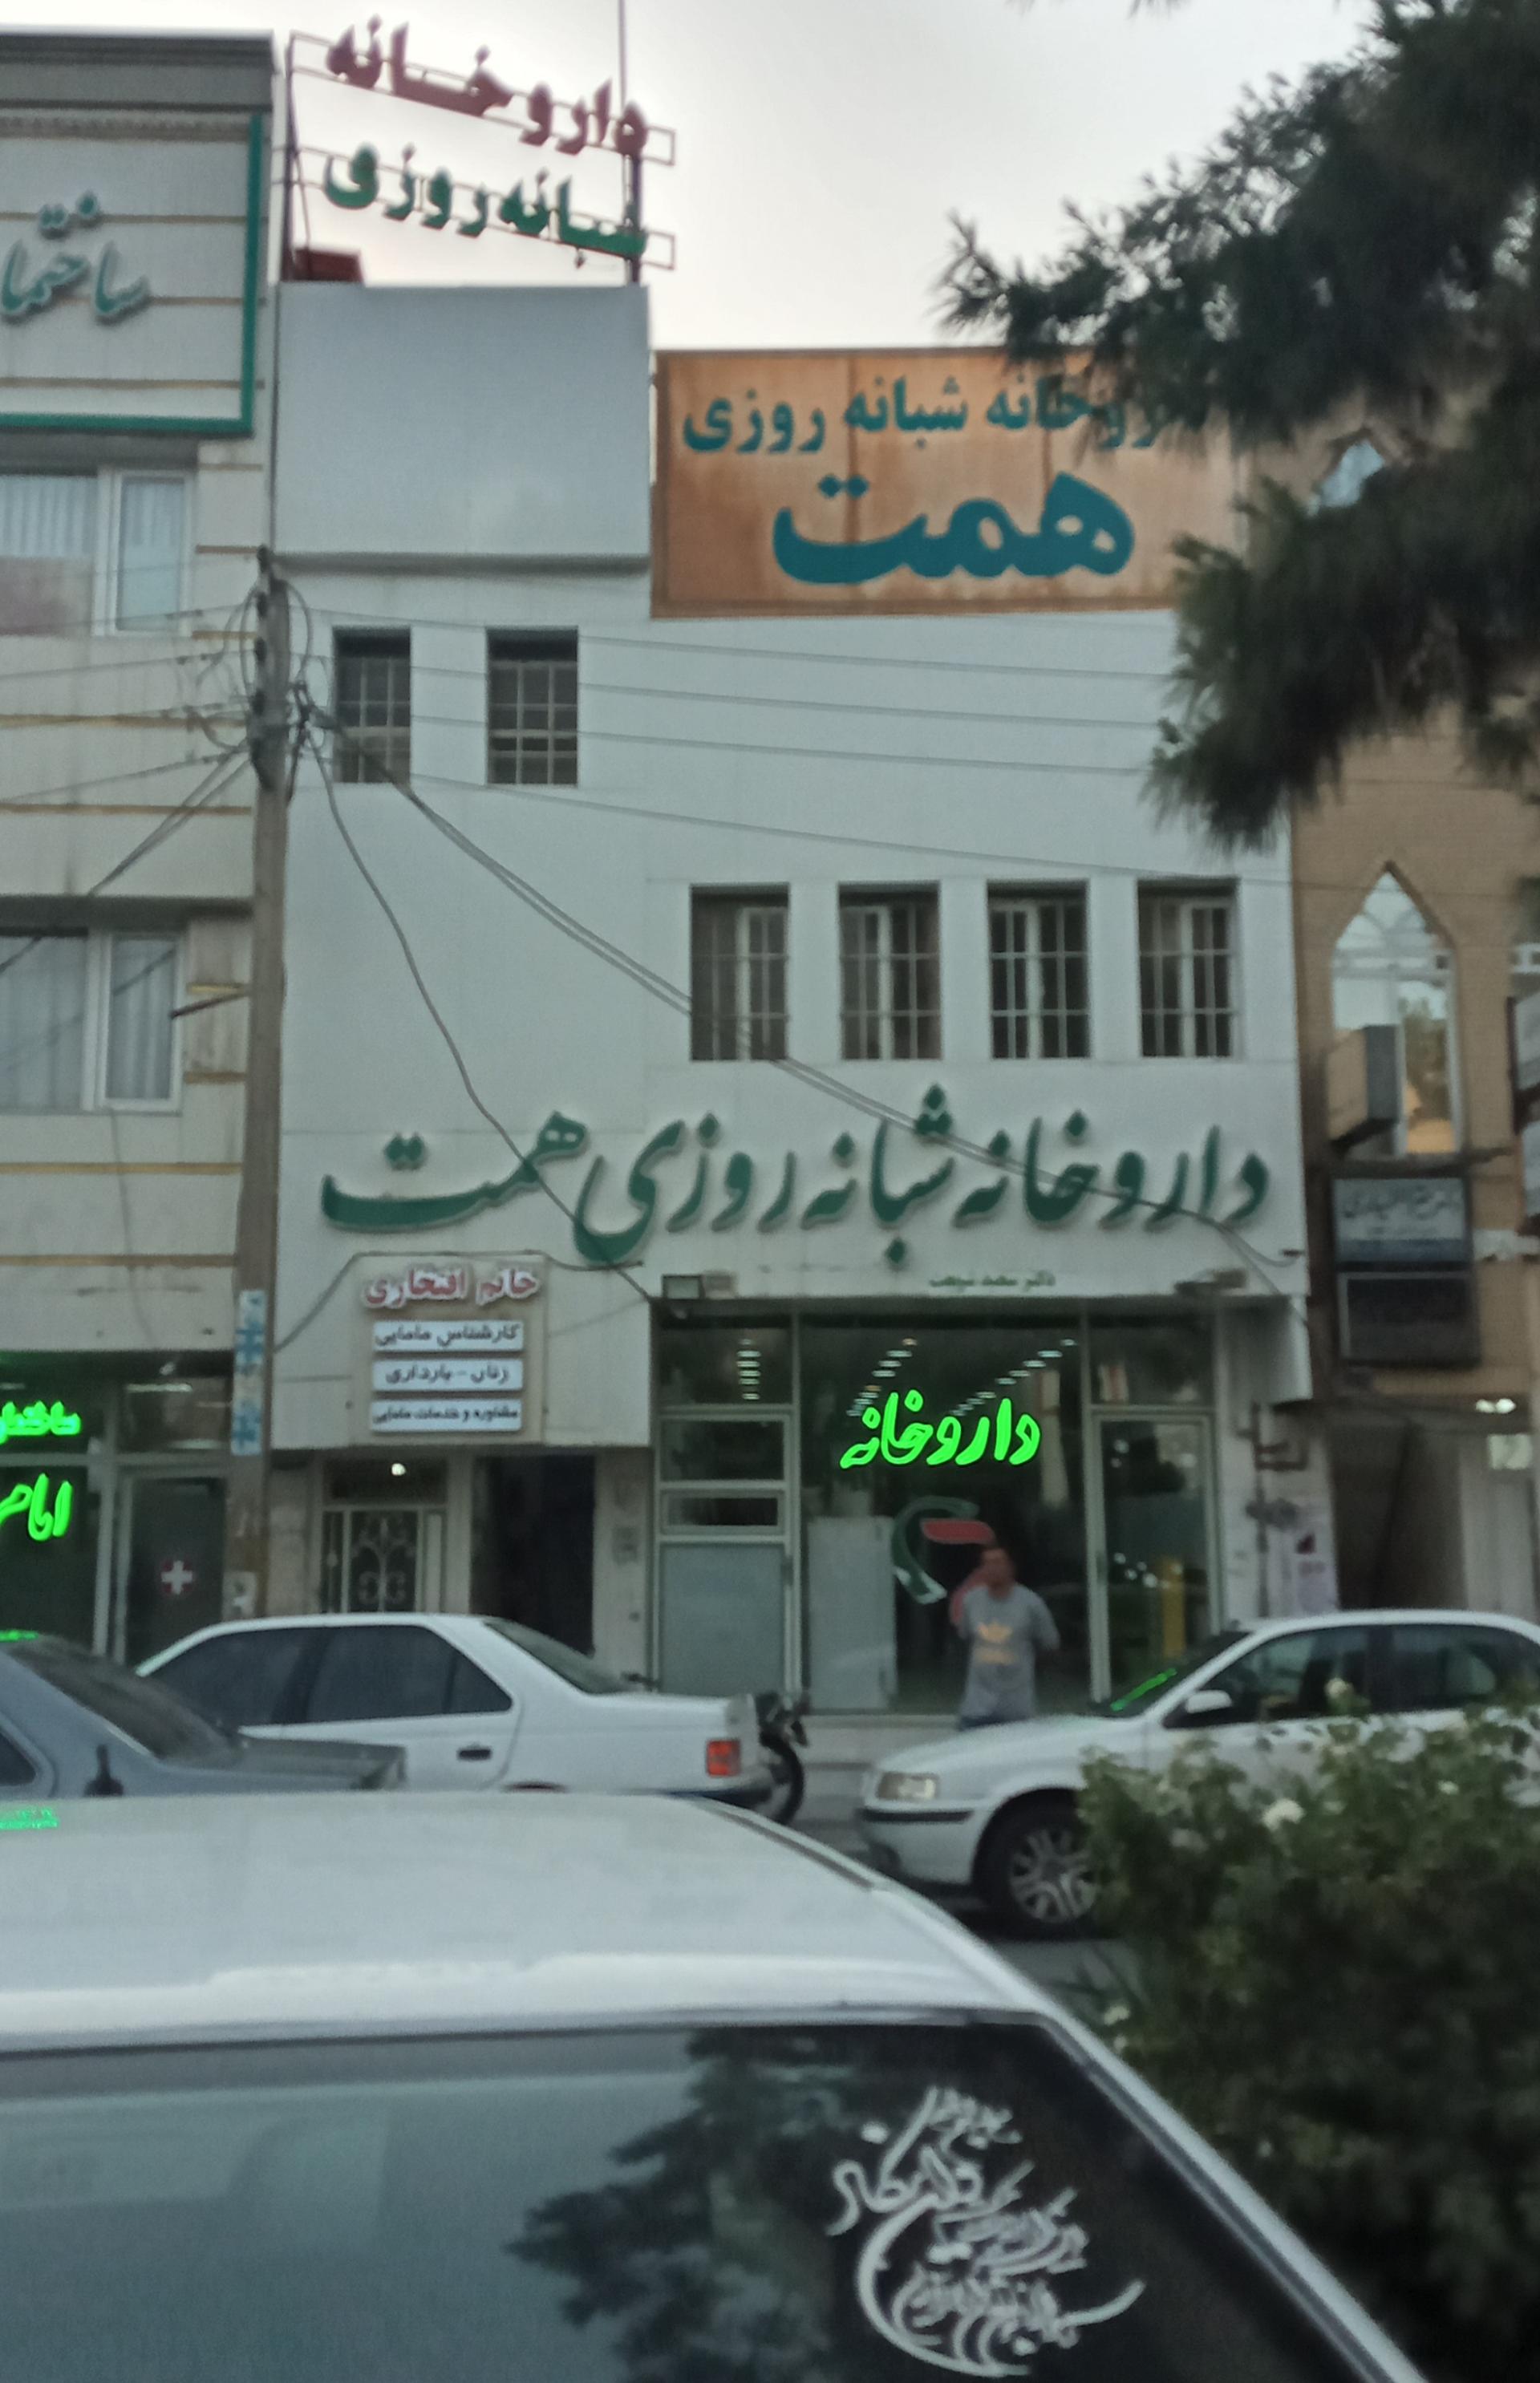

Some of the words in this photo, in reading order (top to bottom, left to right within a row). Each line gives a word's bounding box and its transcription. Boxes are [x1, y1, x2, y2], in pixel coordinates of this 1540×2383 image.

[323, 142, 488, 239] روزی
[683, 388, 825, 453] روزی
[843, 375, 969, 449] شبانه
[772, 471, 1136, 585] همت
[321, 1110, 587, 1232] همت
[573, 1112, 797, 1265] روزی
[800, 1083, 954, 1269] شبانه
[954, 1108, 1269, 1232] داروخانه
[437, 1325, 520, 1348] کارشناس
[840, 1389, 1041, 1469] داروخانه
